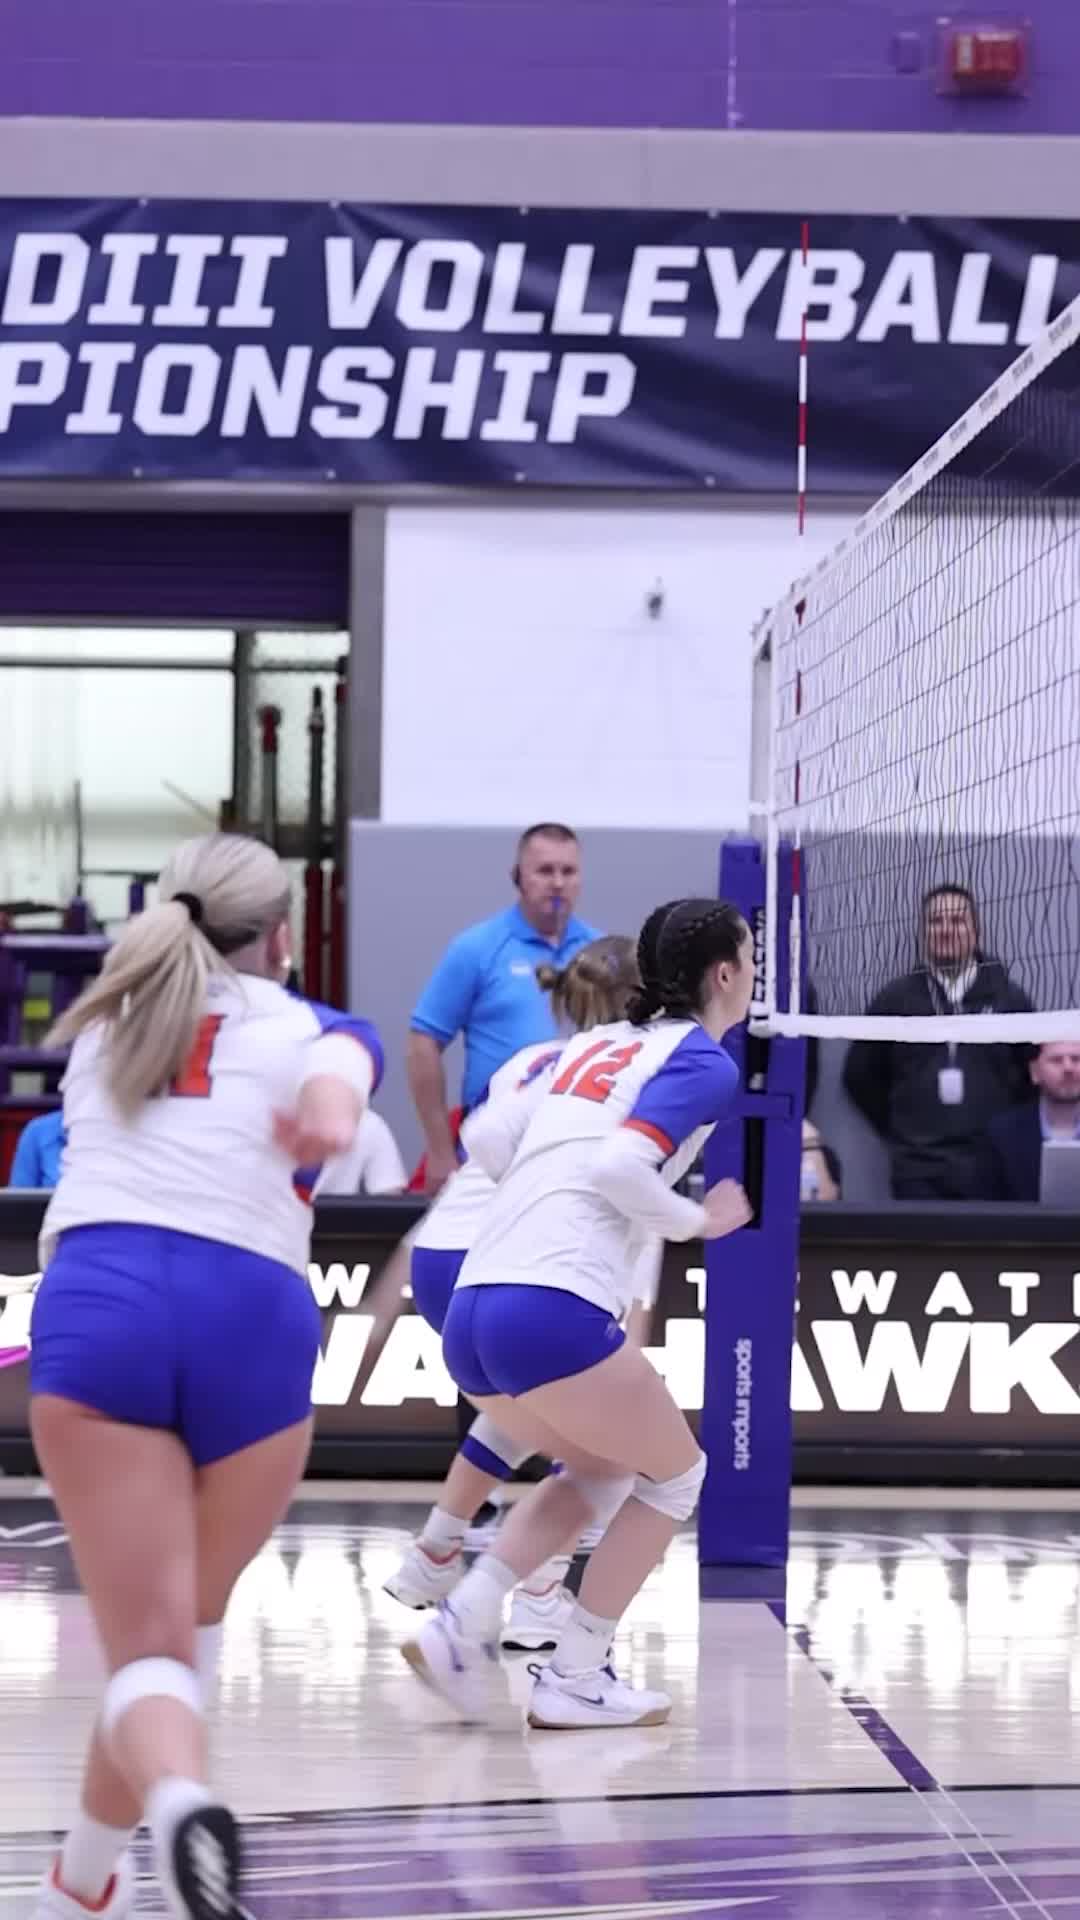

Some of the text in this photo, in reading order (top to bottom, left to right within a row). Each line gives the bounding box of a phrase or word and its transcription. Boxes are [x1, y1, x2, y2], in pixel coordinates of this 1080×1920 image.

[2, 233, 1059, 345] DIII VOLLEYBALL
[0, 342, 637, 443] PIONSHIP
[549, 1039, 643, 1104] 12
[731, 1338, 752, 1470] sports imports
